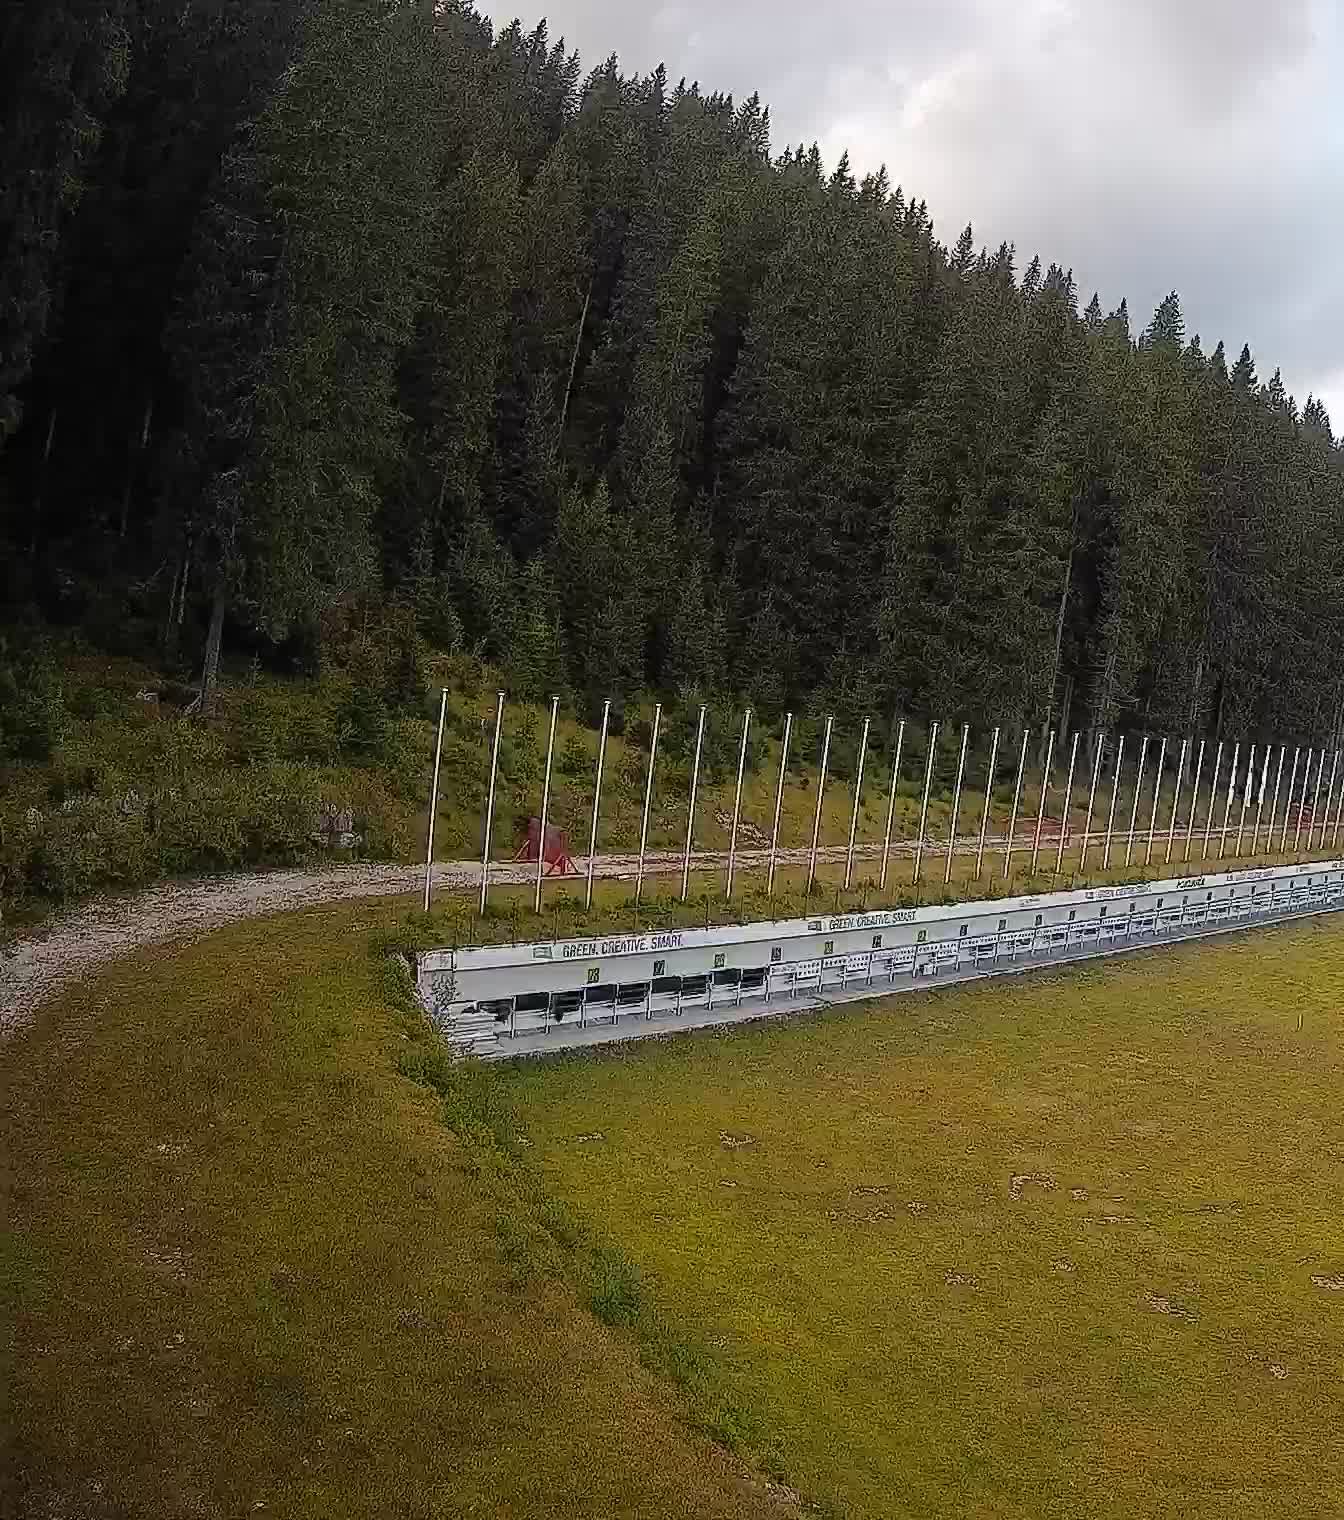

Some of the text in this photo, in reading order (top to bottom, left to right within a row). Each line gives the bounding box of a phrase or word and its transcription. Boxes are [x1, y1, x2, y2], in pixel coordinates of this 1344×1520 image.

[562, 943, 598, 958] GREEN.
[601, 938, 648, 955] CREATIVE.
[651, 934, 683, 949] SMART.
